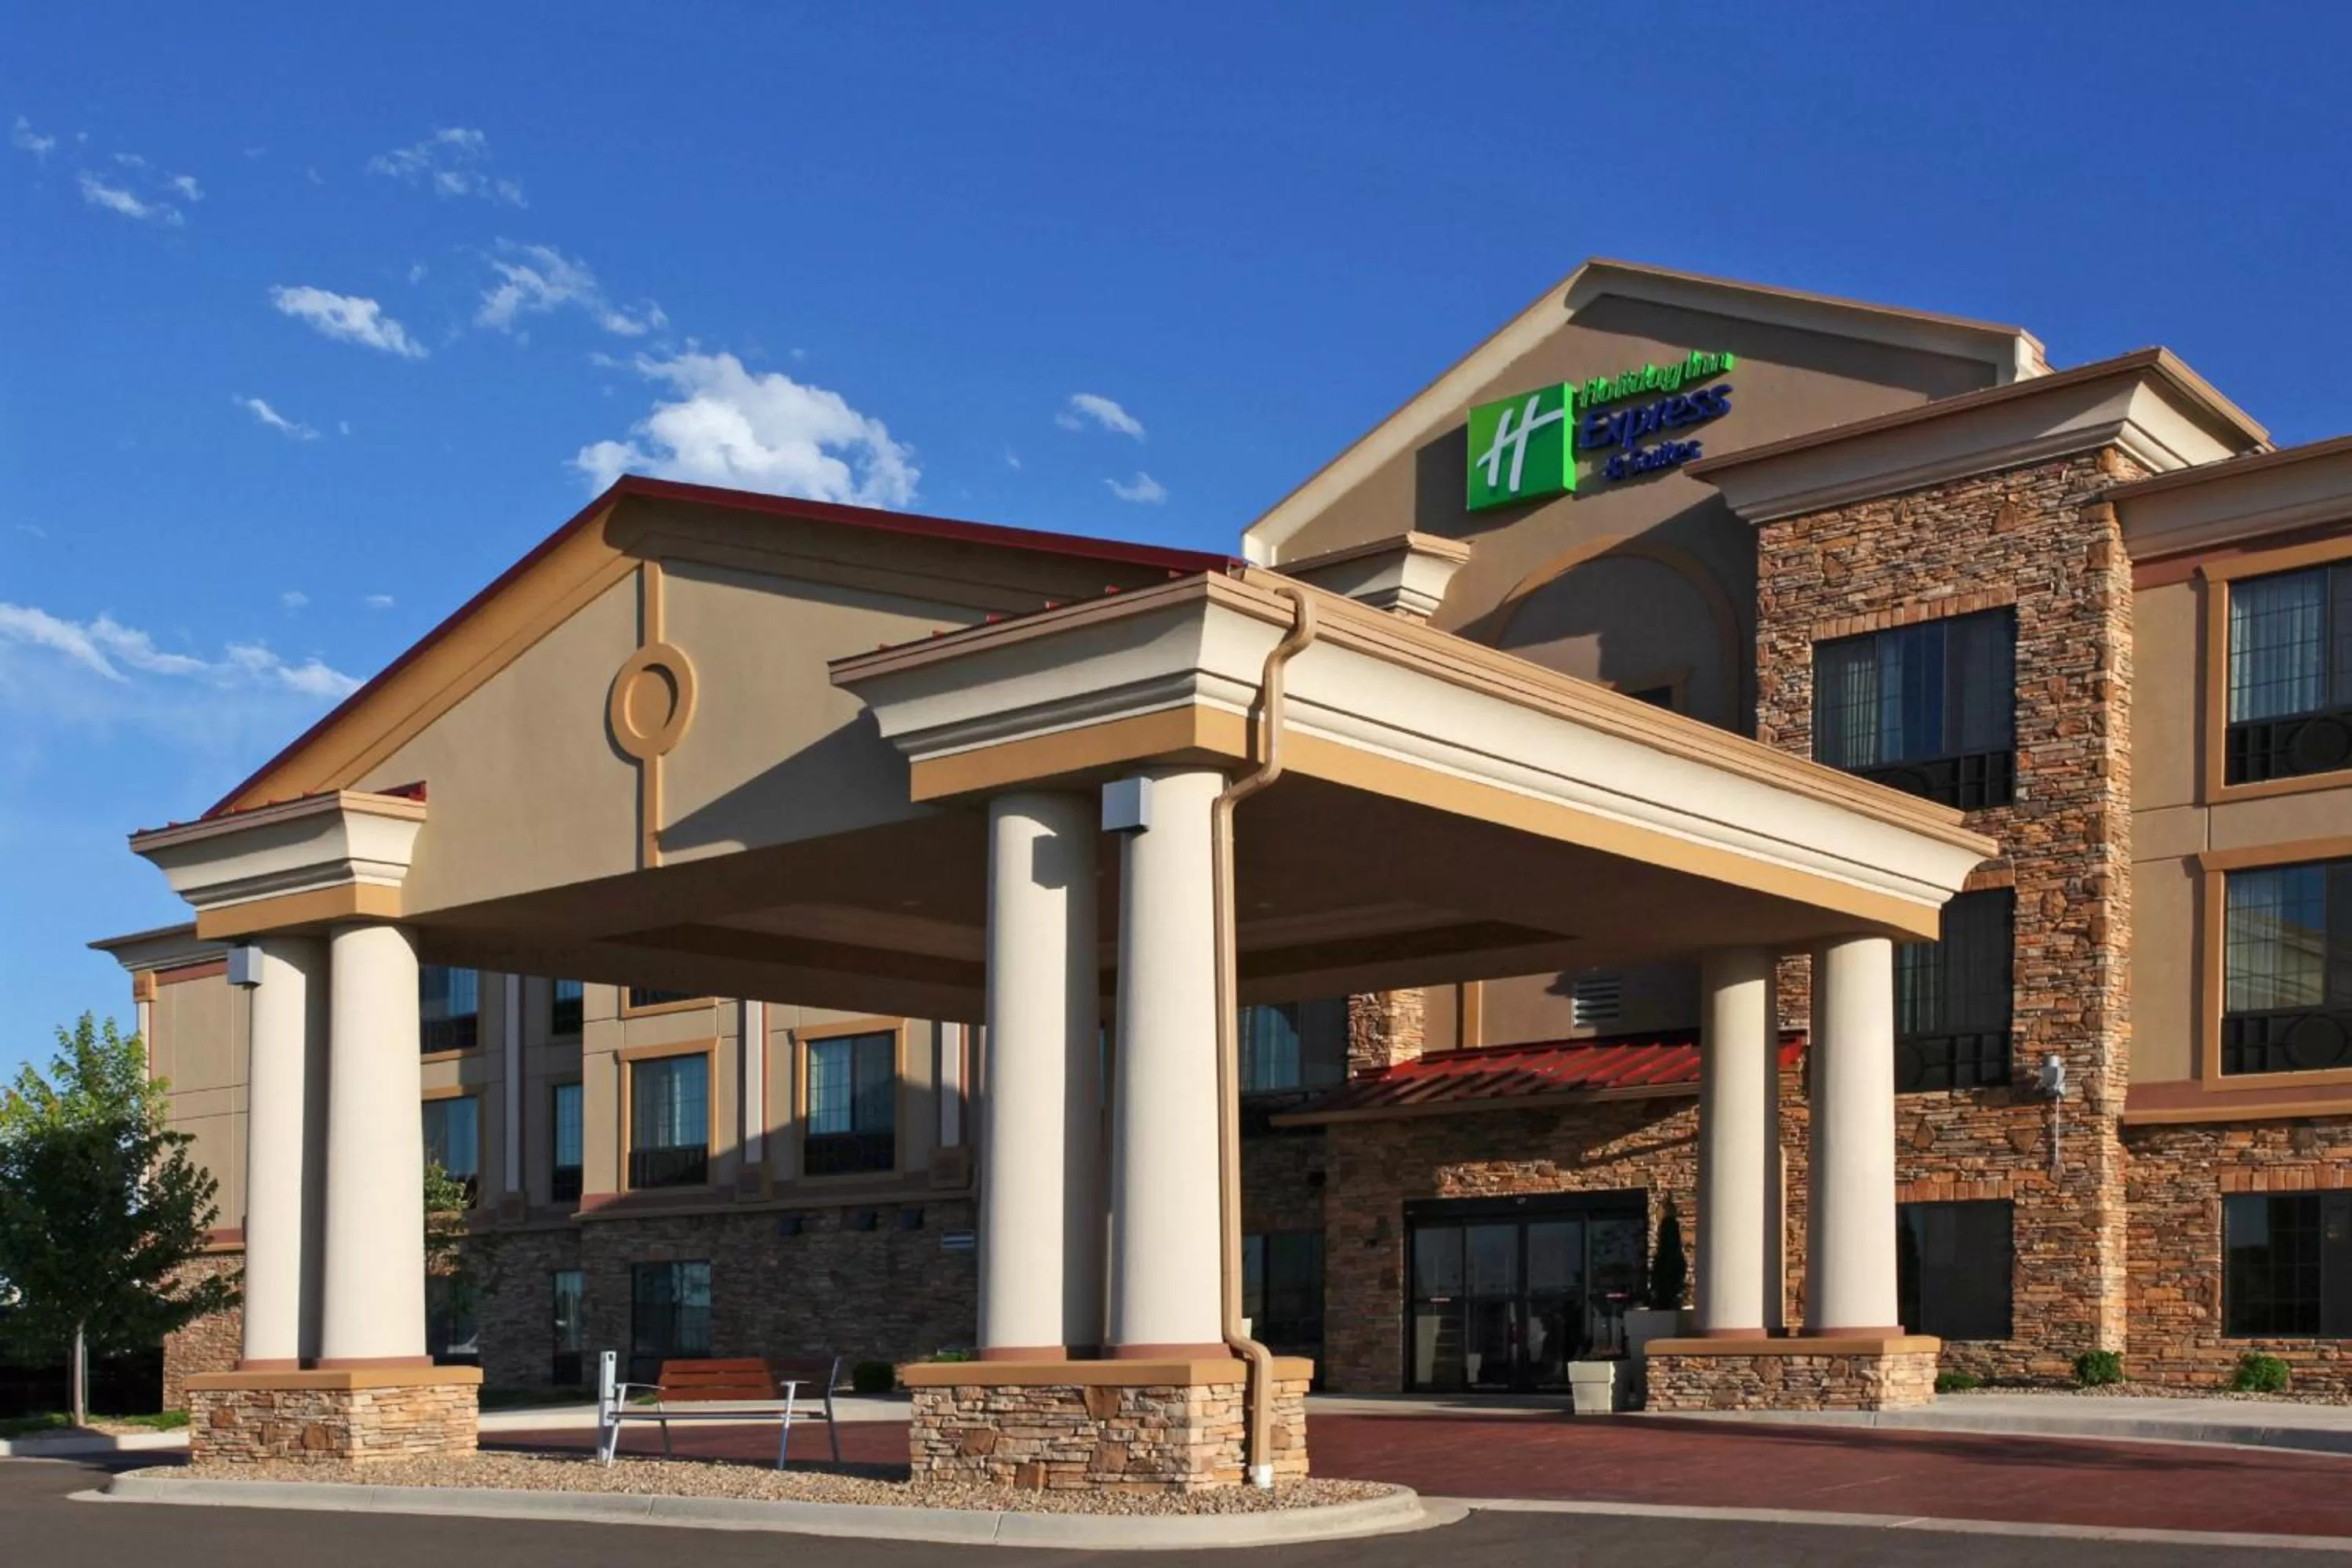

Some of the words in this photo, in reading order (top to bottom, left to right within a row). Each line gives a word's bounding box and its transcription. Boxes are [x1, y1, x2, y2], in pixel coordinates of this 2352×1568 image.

[1579, 363, 1684, 408] Holiday
[1686, 350, 1733, 379] Inn
[1578, 383, 1733, 451] Express
[1602, 455, 1624, 481] &
[1631, 440, 1704, 473] Suites
